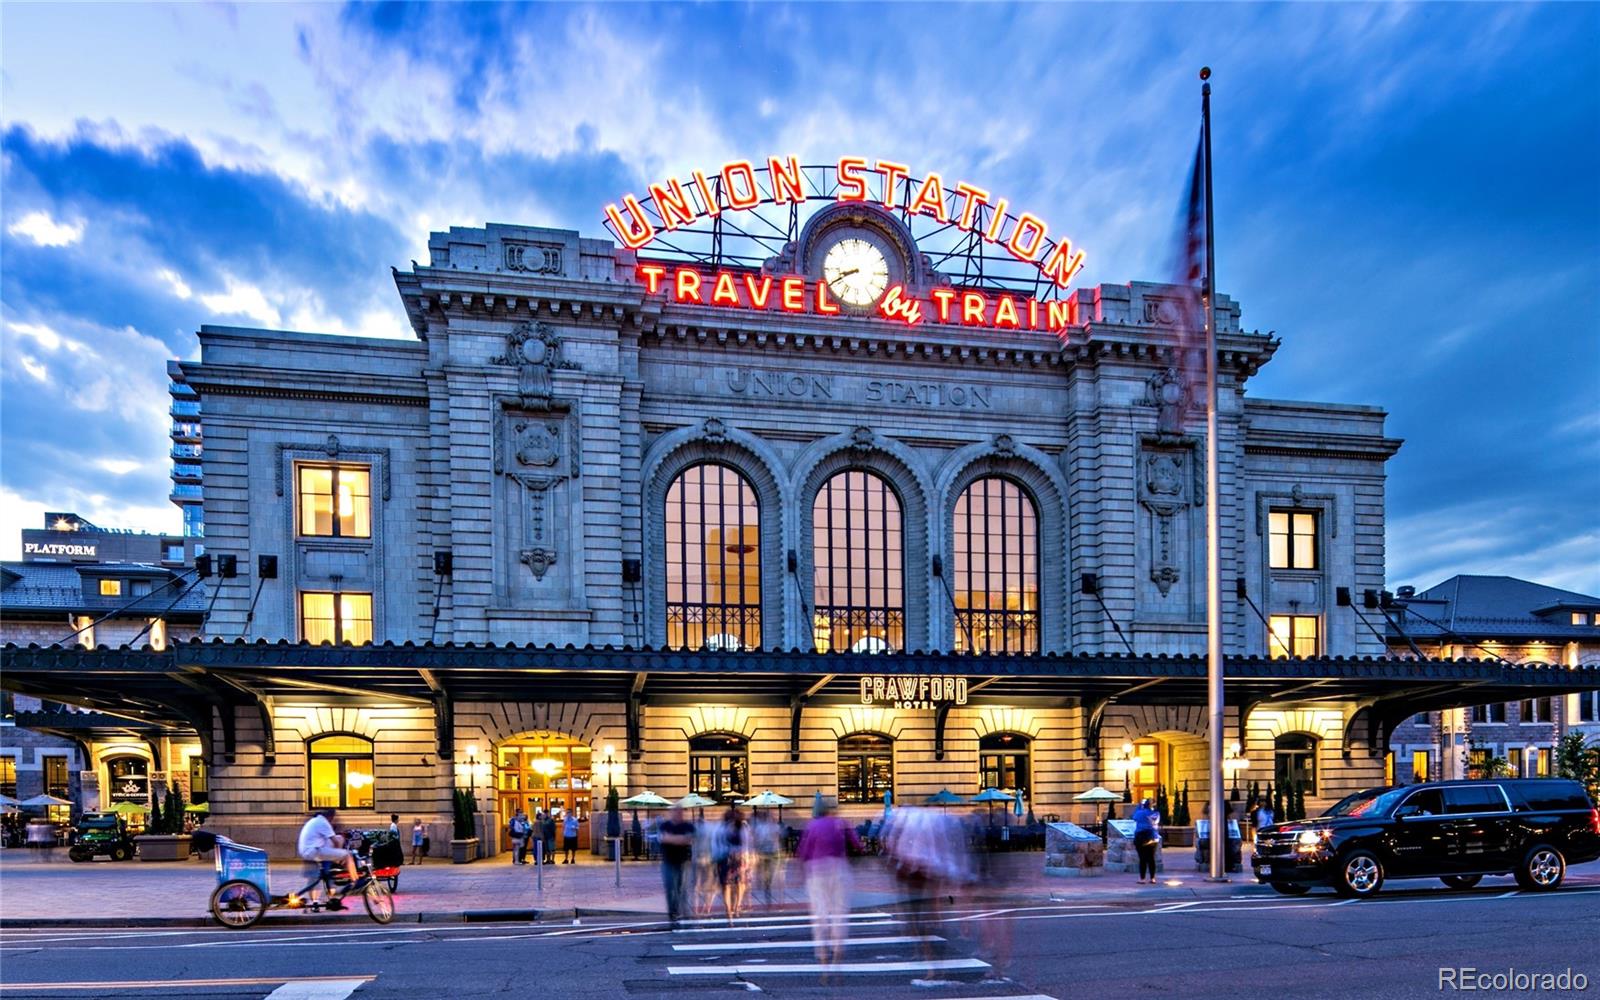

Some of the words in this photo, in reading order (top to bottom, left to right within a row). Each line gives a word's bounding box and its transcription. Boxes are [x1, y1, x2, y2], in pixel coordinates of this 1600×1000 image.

[604, 153, 807, 250] UNION
[836, 155, 1086, 289] STATION
[636, 264, 840, 315] TRAVEL
[880, 285, 922, 325] by
[931, 288, 1070, 331] TRAIN
[726, 371, 833, 398] UNION
[865, 381, 991, 408] STATION
[24, 543, 96, 556] PLATFORM
[860, 676, 968, 705] CRAWFORD
[894, 701, 937, 710] HOTEL
